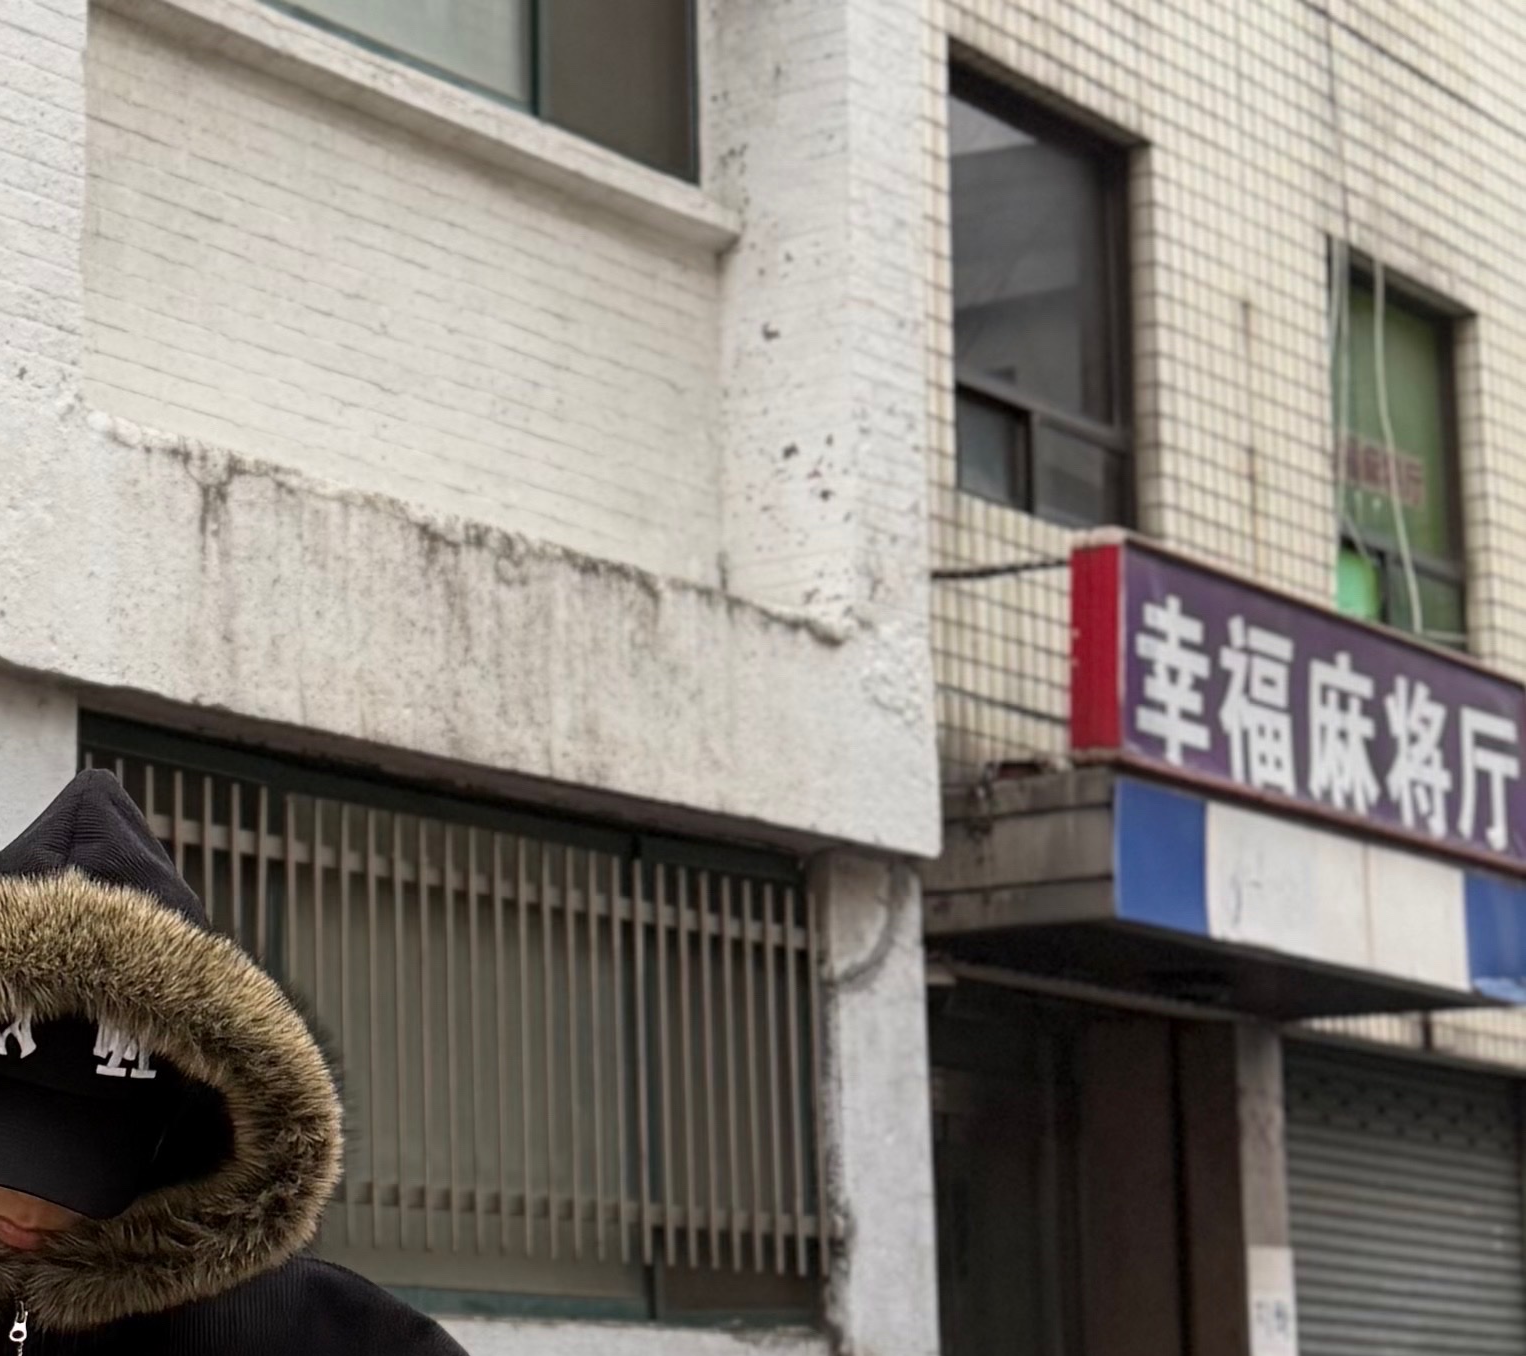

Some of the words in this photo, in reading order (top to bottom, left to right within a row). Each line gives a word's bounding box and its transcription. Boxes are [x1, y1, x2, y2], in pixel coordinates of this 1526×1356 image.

[1135, 595, 1521, 852] 幸福麻将厅
